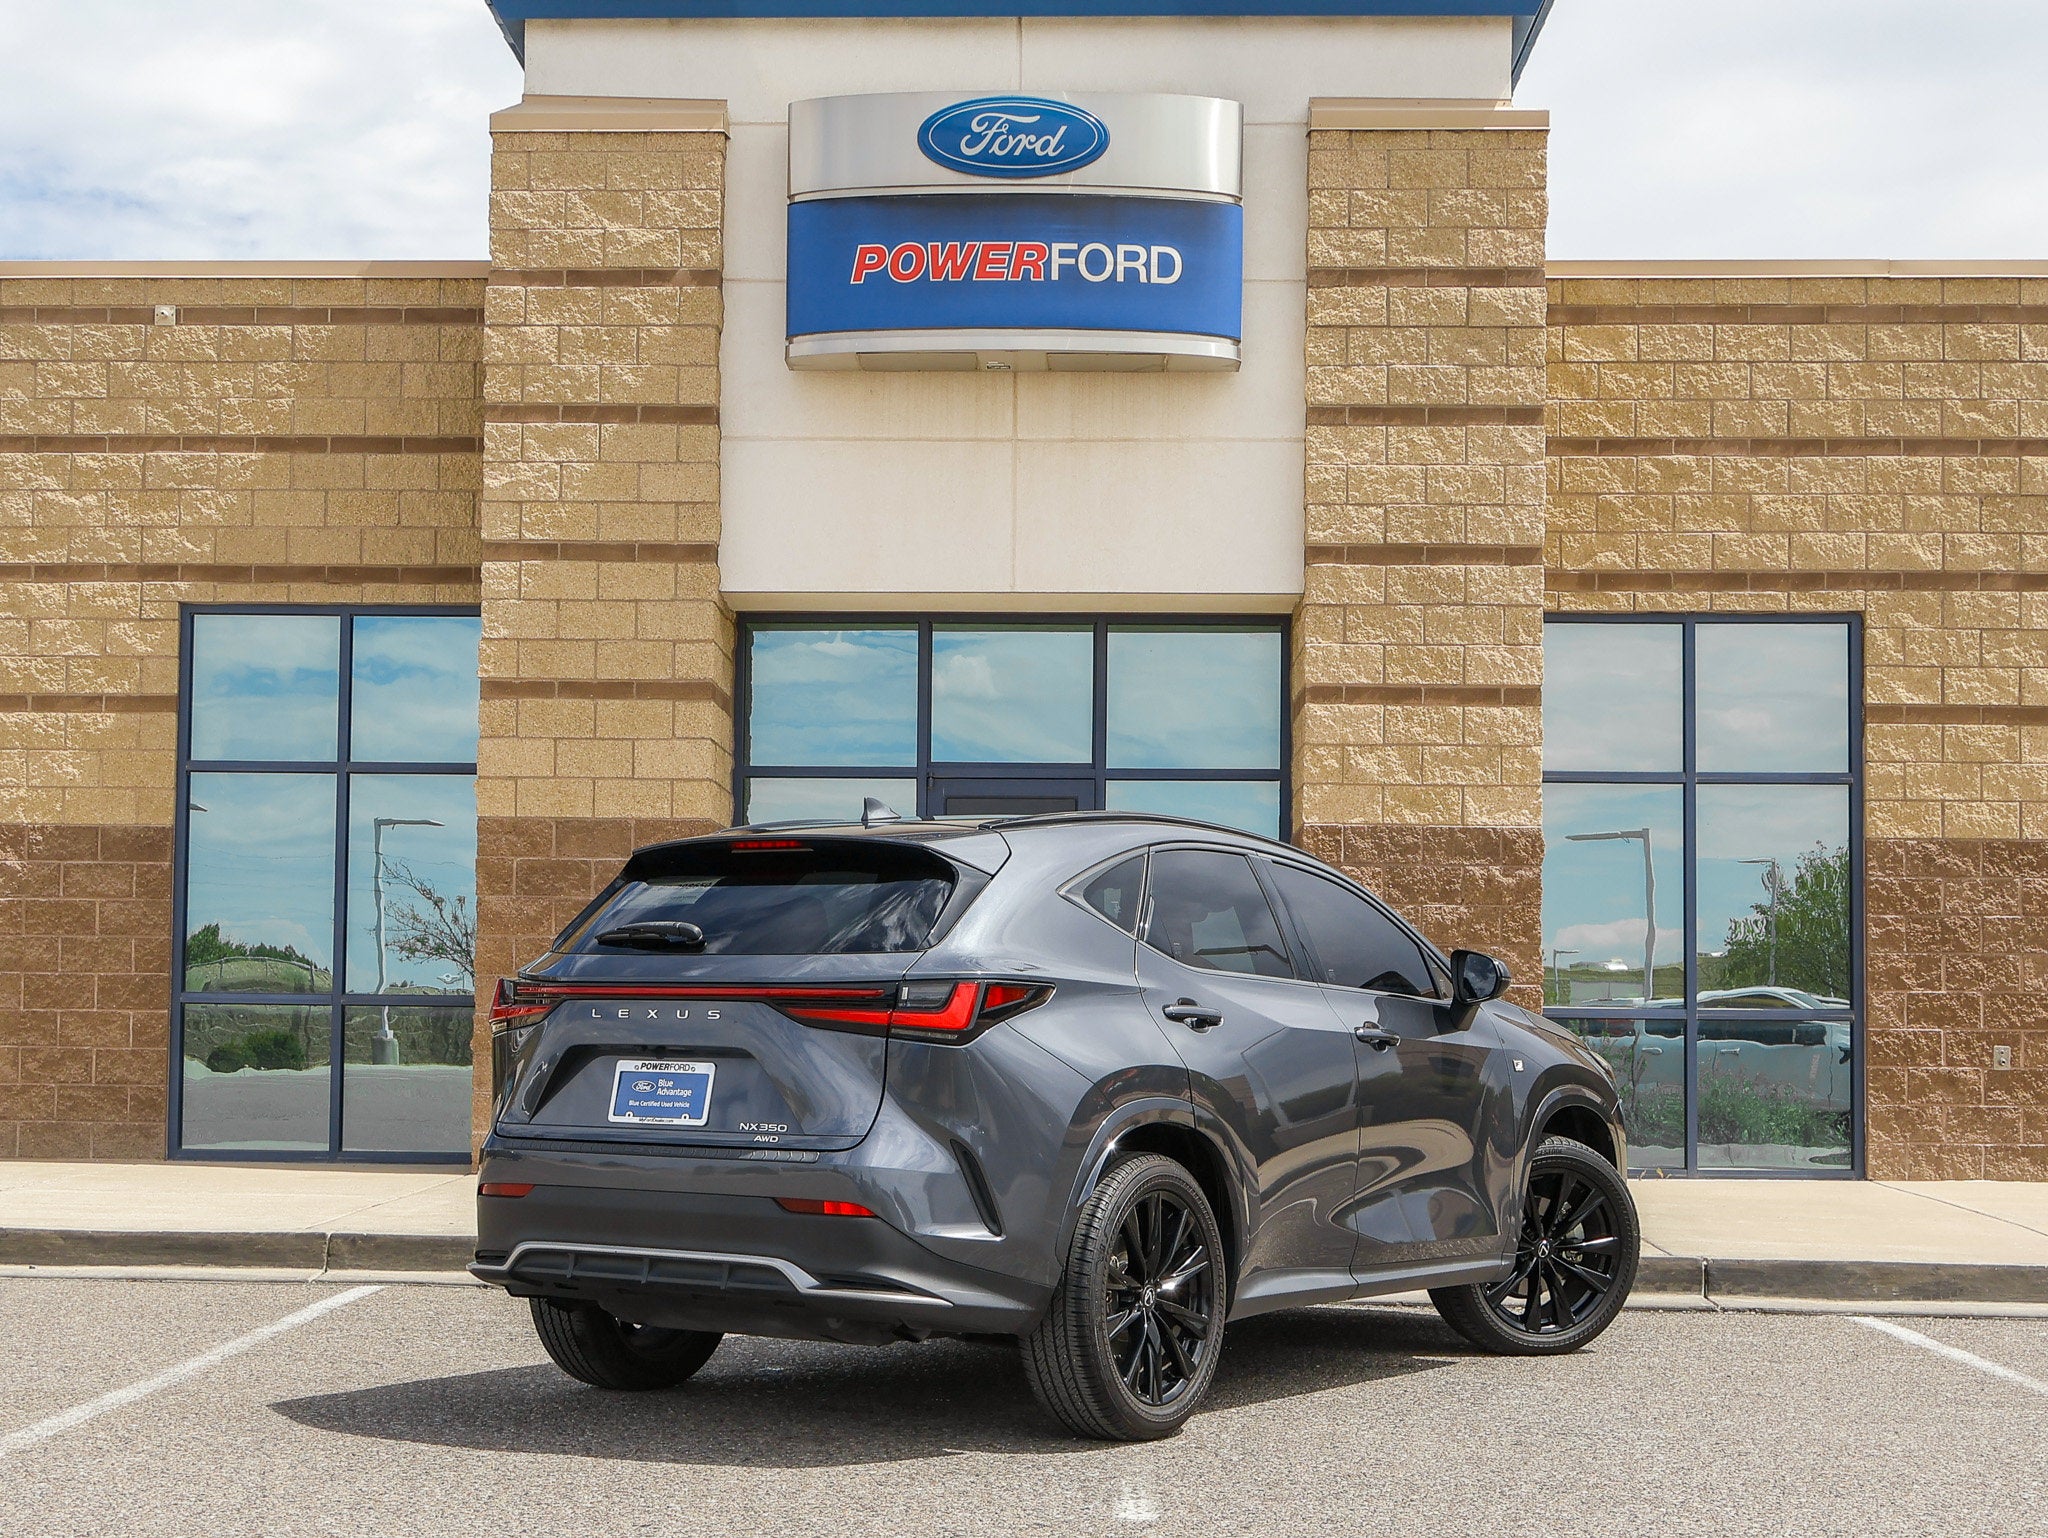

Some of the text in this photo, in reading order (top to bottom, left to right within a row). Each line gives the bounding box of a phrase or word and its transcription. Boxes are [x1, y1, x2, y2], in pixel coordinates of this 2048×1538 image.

[960, 111, 1068, 157] Ford
[849, 241, 1184, 284] POWERFORD
[591, 1008, 721, 1020] LEXUS
[657, 1079, 673, 1087] Blue
[656, 1088, 692, 1097] Advantage
[739, 1122, 788, 1132] NX350
[753, 1135, 779, 1143] AWD
